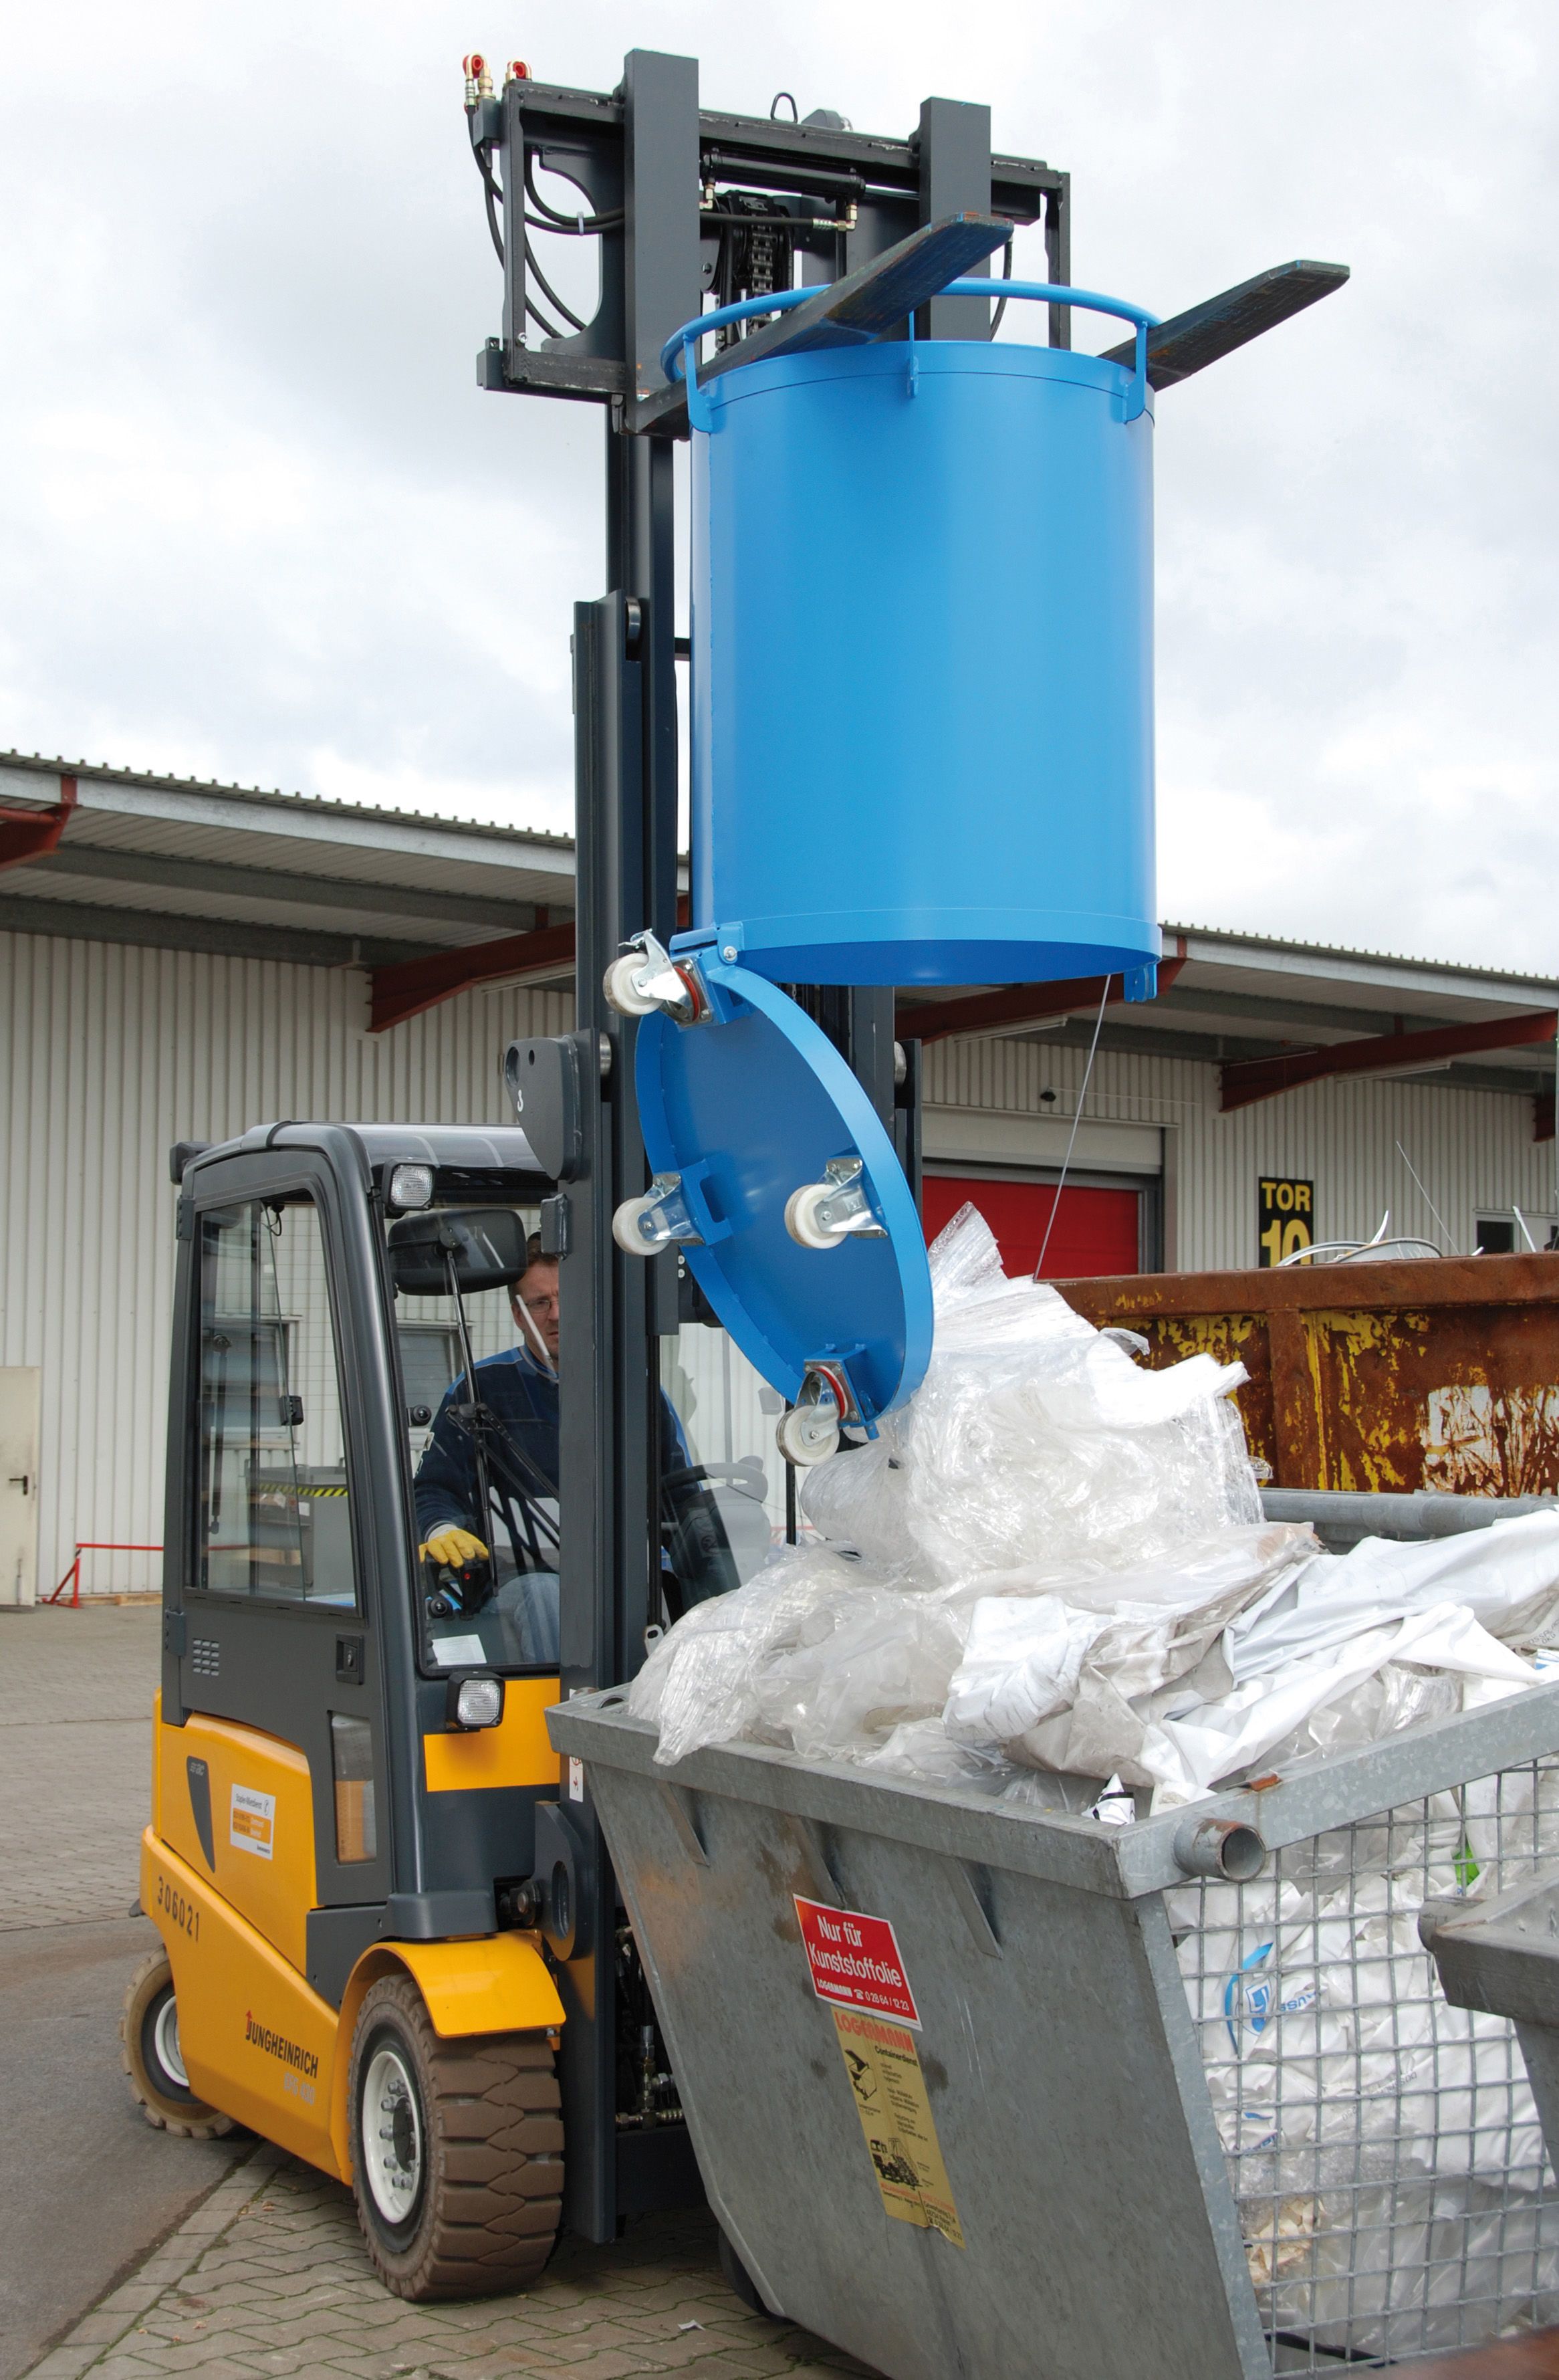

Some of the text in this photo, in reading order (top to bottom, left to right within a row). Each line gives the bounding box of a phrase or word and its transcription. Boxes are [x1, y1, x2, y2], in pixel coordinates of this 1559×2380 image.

[1262, 1182, 1311, 1212] TOR
[1262, 1219, 1312, 1267] 10
[158, 1875, 200, 1942] 306021
[817, 1915, 862, 1947] Nur für
[808, 1941, 903, 1988] Kunststoffolie
[245, 2020, 319, 2078] JUNGHEINRICH
